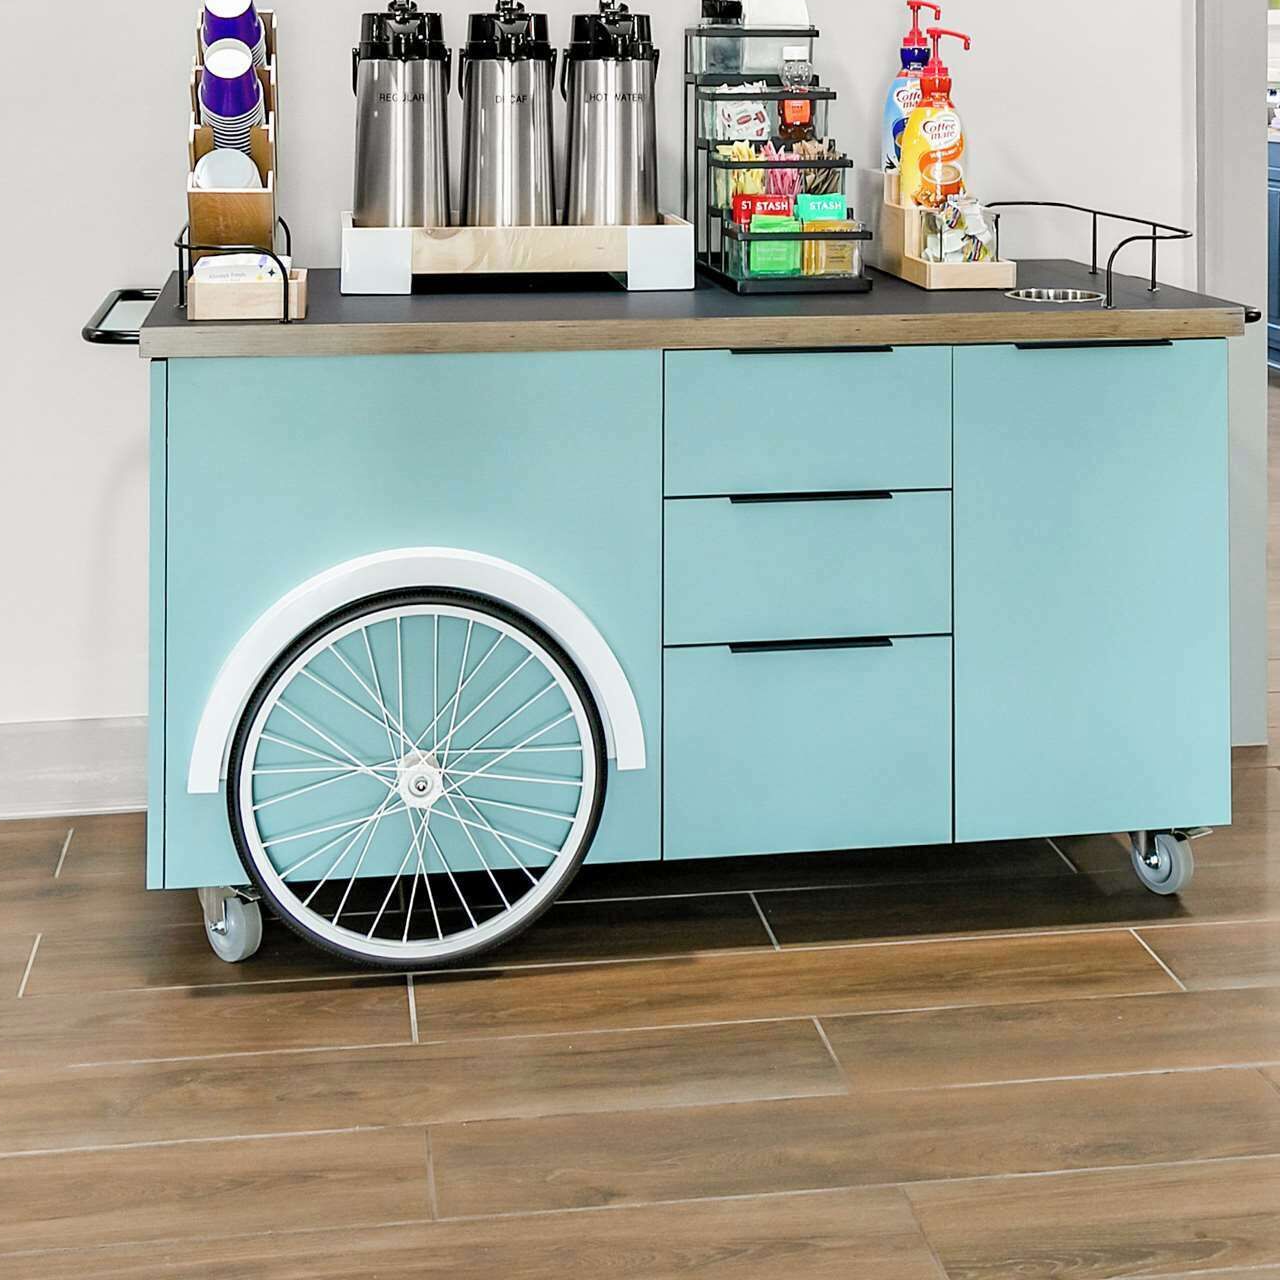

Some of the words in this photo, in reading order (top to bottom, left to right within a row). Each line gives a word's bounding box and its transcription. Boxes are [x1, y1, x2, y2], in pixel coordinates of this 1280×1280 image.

[589, 93, 608, 102] HOT
[922, 120, 956, 135] Coffee
[756, 201, 789, 211] STASH
[808, 200, 841, 210] STASH
